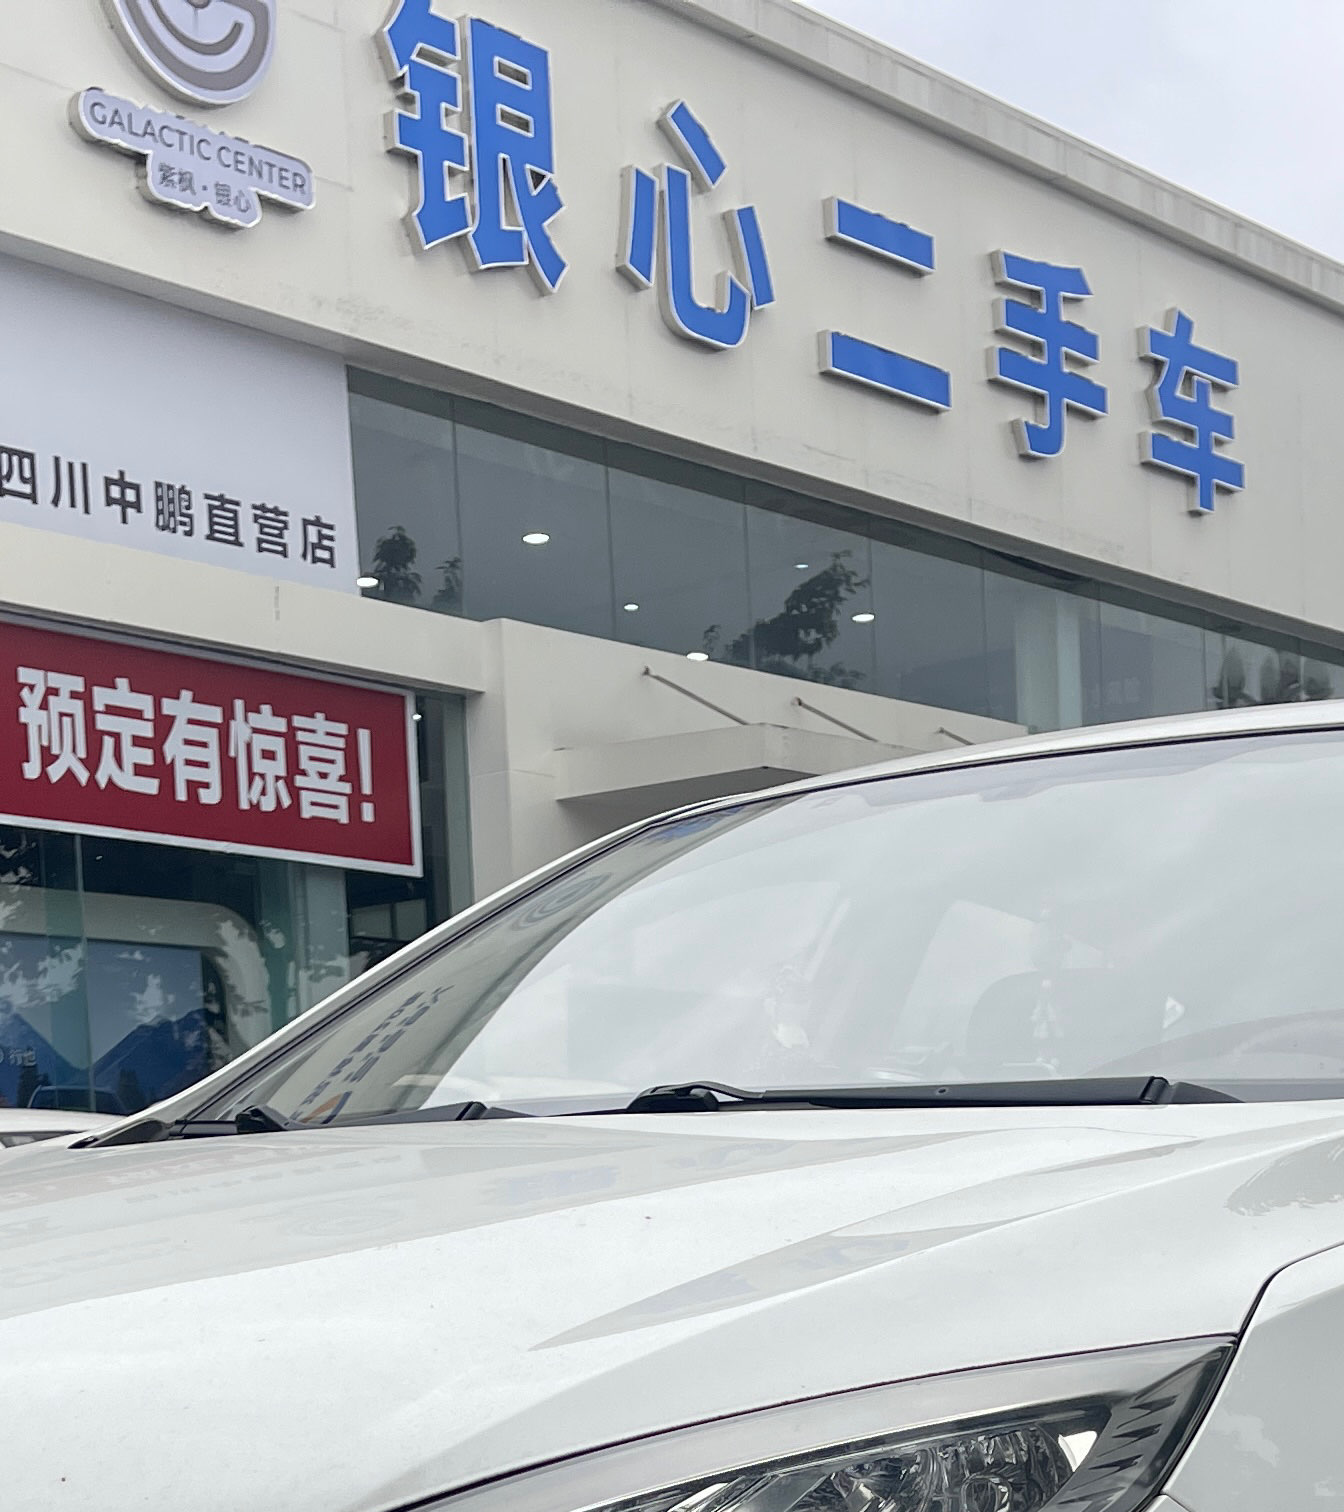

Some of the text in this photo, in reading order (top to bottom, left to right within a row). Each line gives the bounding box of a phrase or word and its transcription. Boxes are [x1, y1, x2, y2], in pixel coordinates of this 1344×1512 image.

[89, 101, 307, 195] GALACTIC CENTER
[385, 0, 1246, 516] 银心二手车
